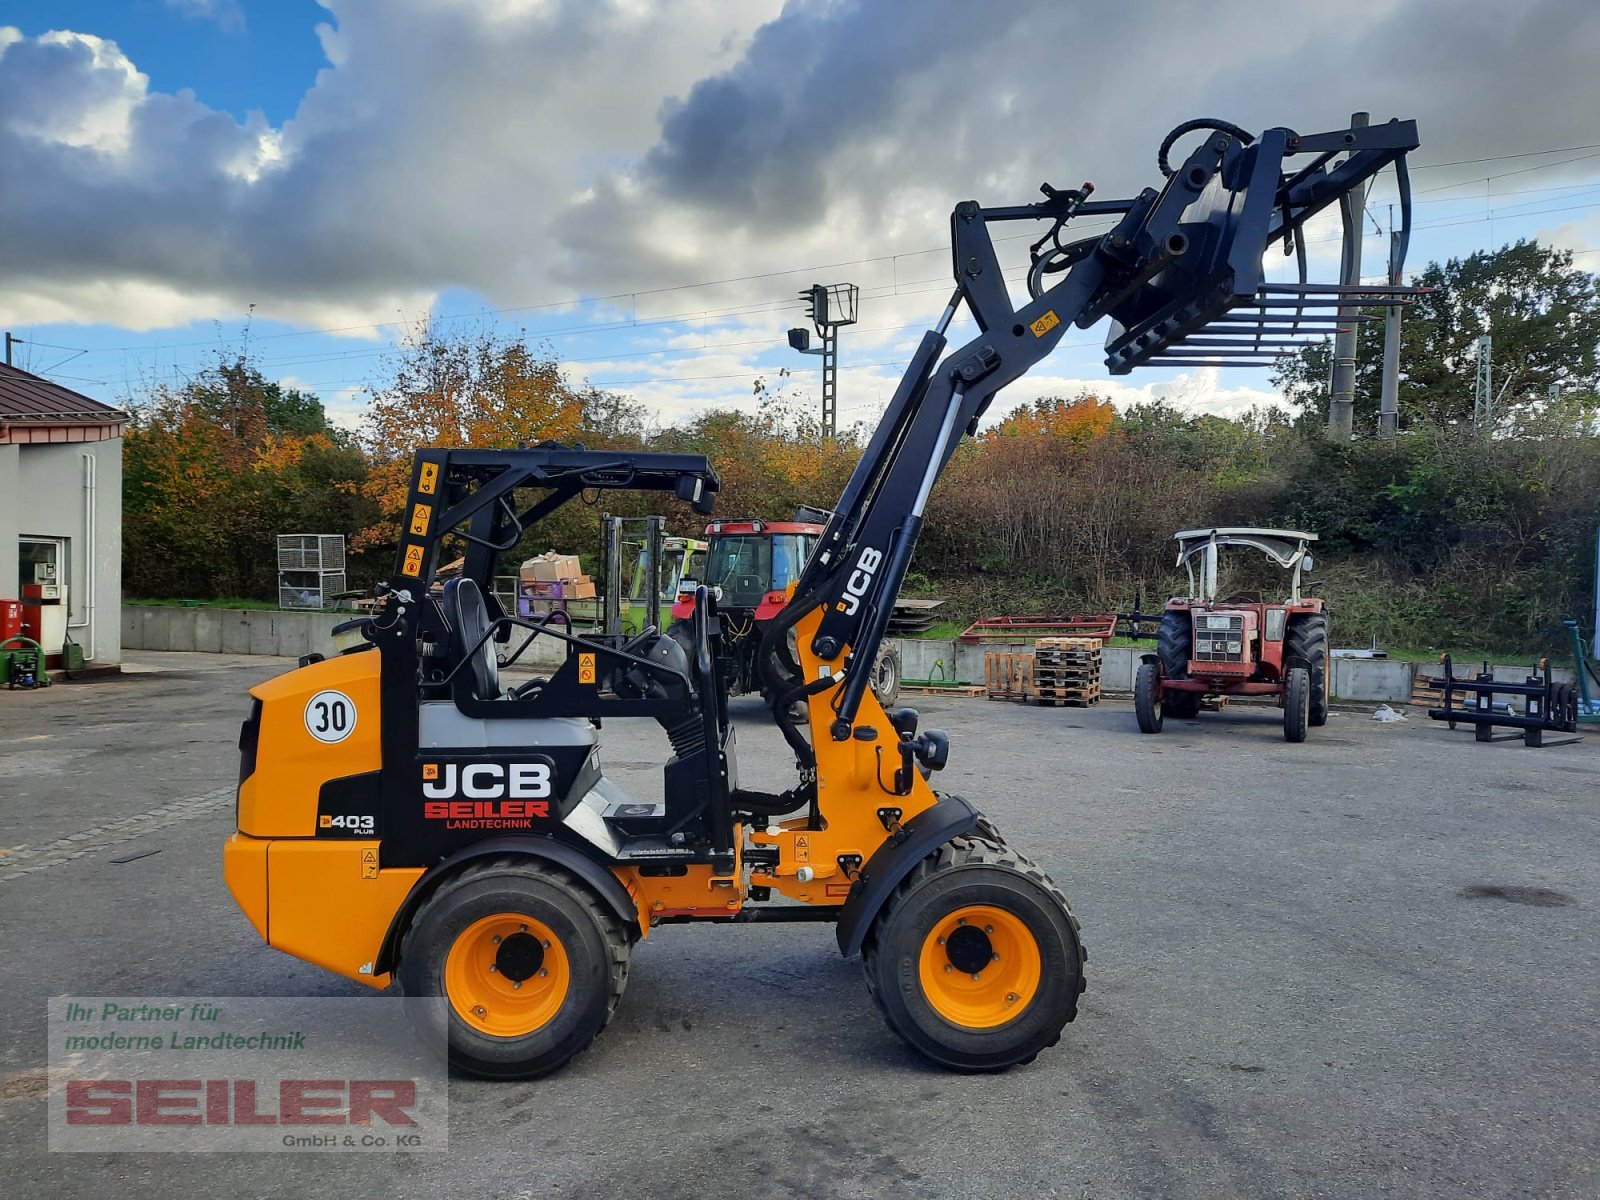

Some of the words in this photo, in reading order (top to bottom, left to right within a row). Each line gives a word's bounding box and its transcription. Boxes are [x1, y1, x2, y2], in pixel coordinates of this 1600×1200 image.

[841, 546, 882, 616] JCB
[315, 701, 346, 732] 30
[422, 763, 551, 799] JCB
[331, 815, 374, 828] 403
[424, 801, 549, 819] SEILER
[446, 819, 532, 829] LANDTECHNIK
